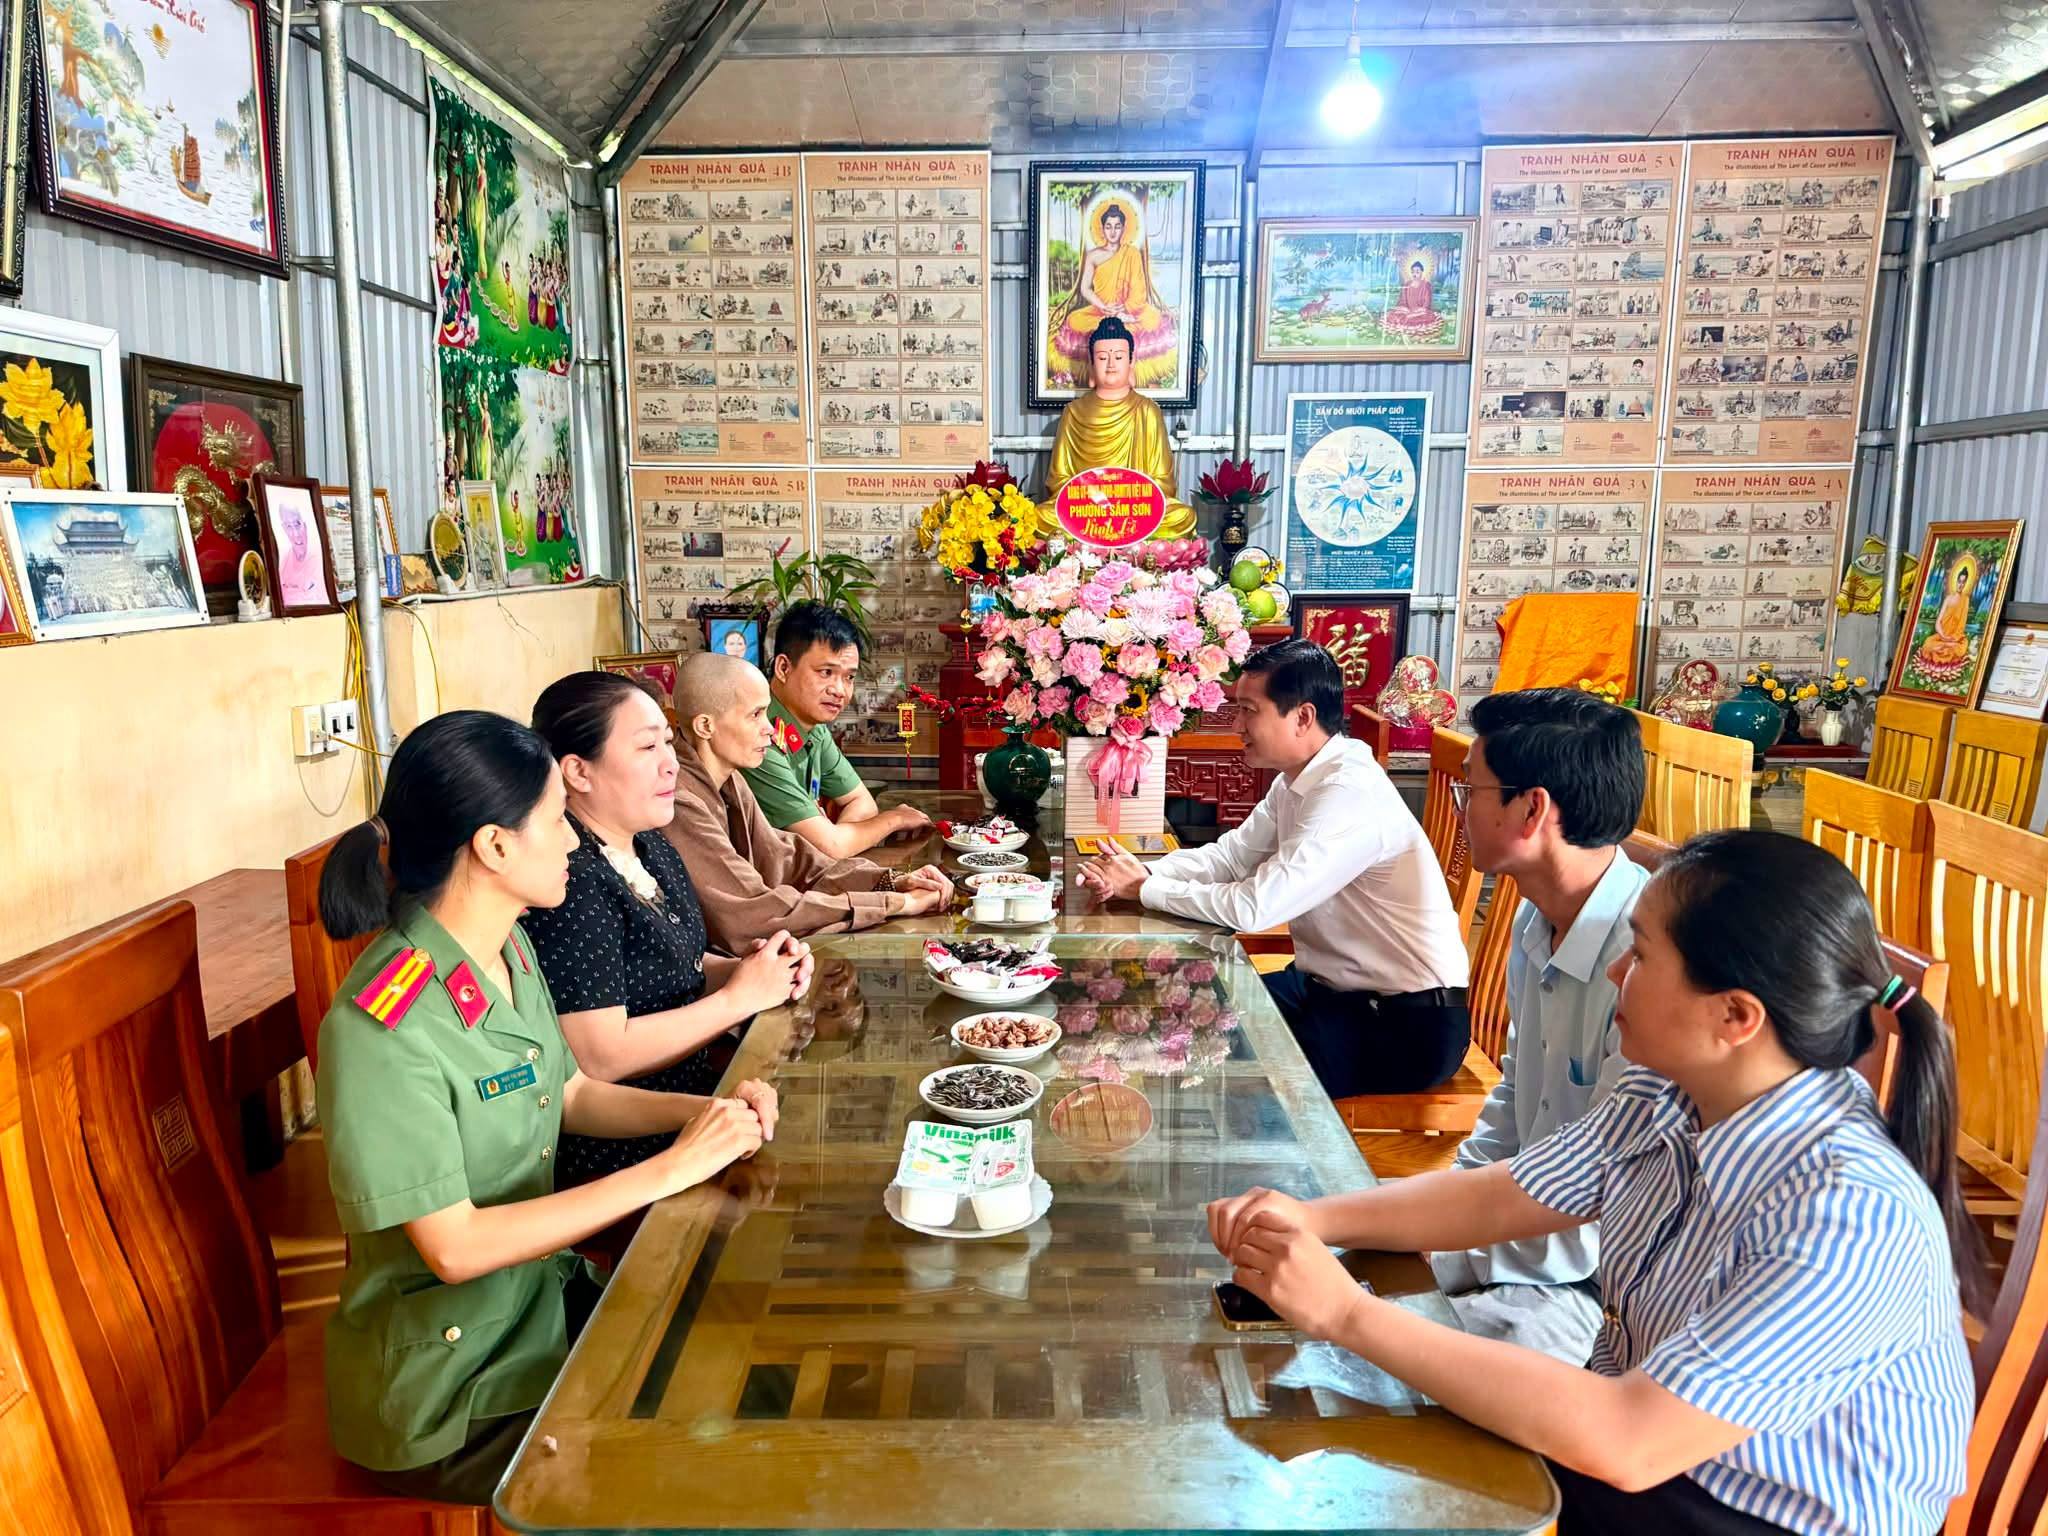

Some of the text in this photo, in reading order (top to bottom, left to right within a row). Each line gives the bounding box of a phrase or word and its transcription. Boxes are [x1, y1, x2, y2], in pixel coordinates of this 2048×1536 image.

[1728, 150, 1769, 160] TRANH
[1520, 156, 1562, 166] TRANH
[650, 165, 688, 175] TRANH
[838, 161, 877, 172] TRANH
[665, 476, 703, 486] TRANH
[846, 477, 885, 488] TRANH
[1500, 477, 1541, 488] TRANH
[1695, 477, 1736, 487] TRANH
